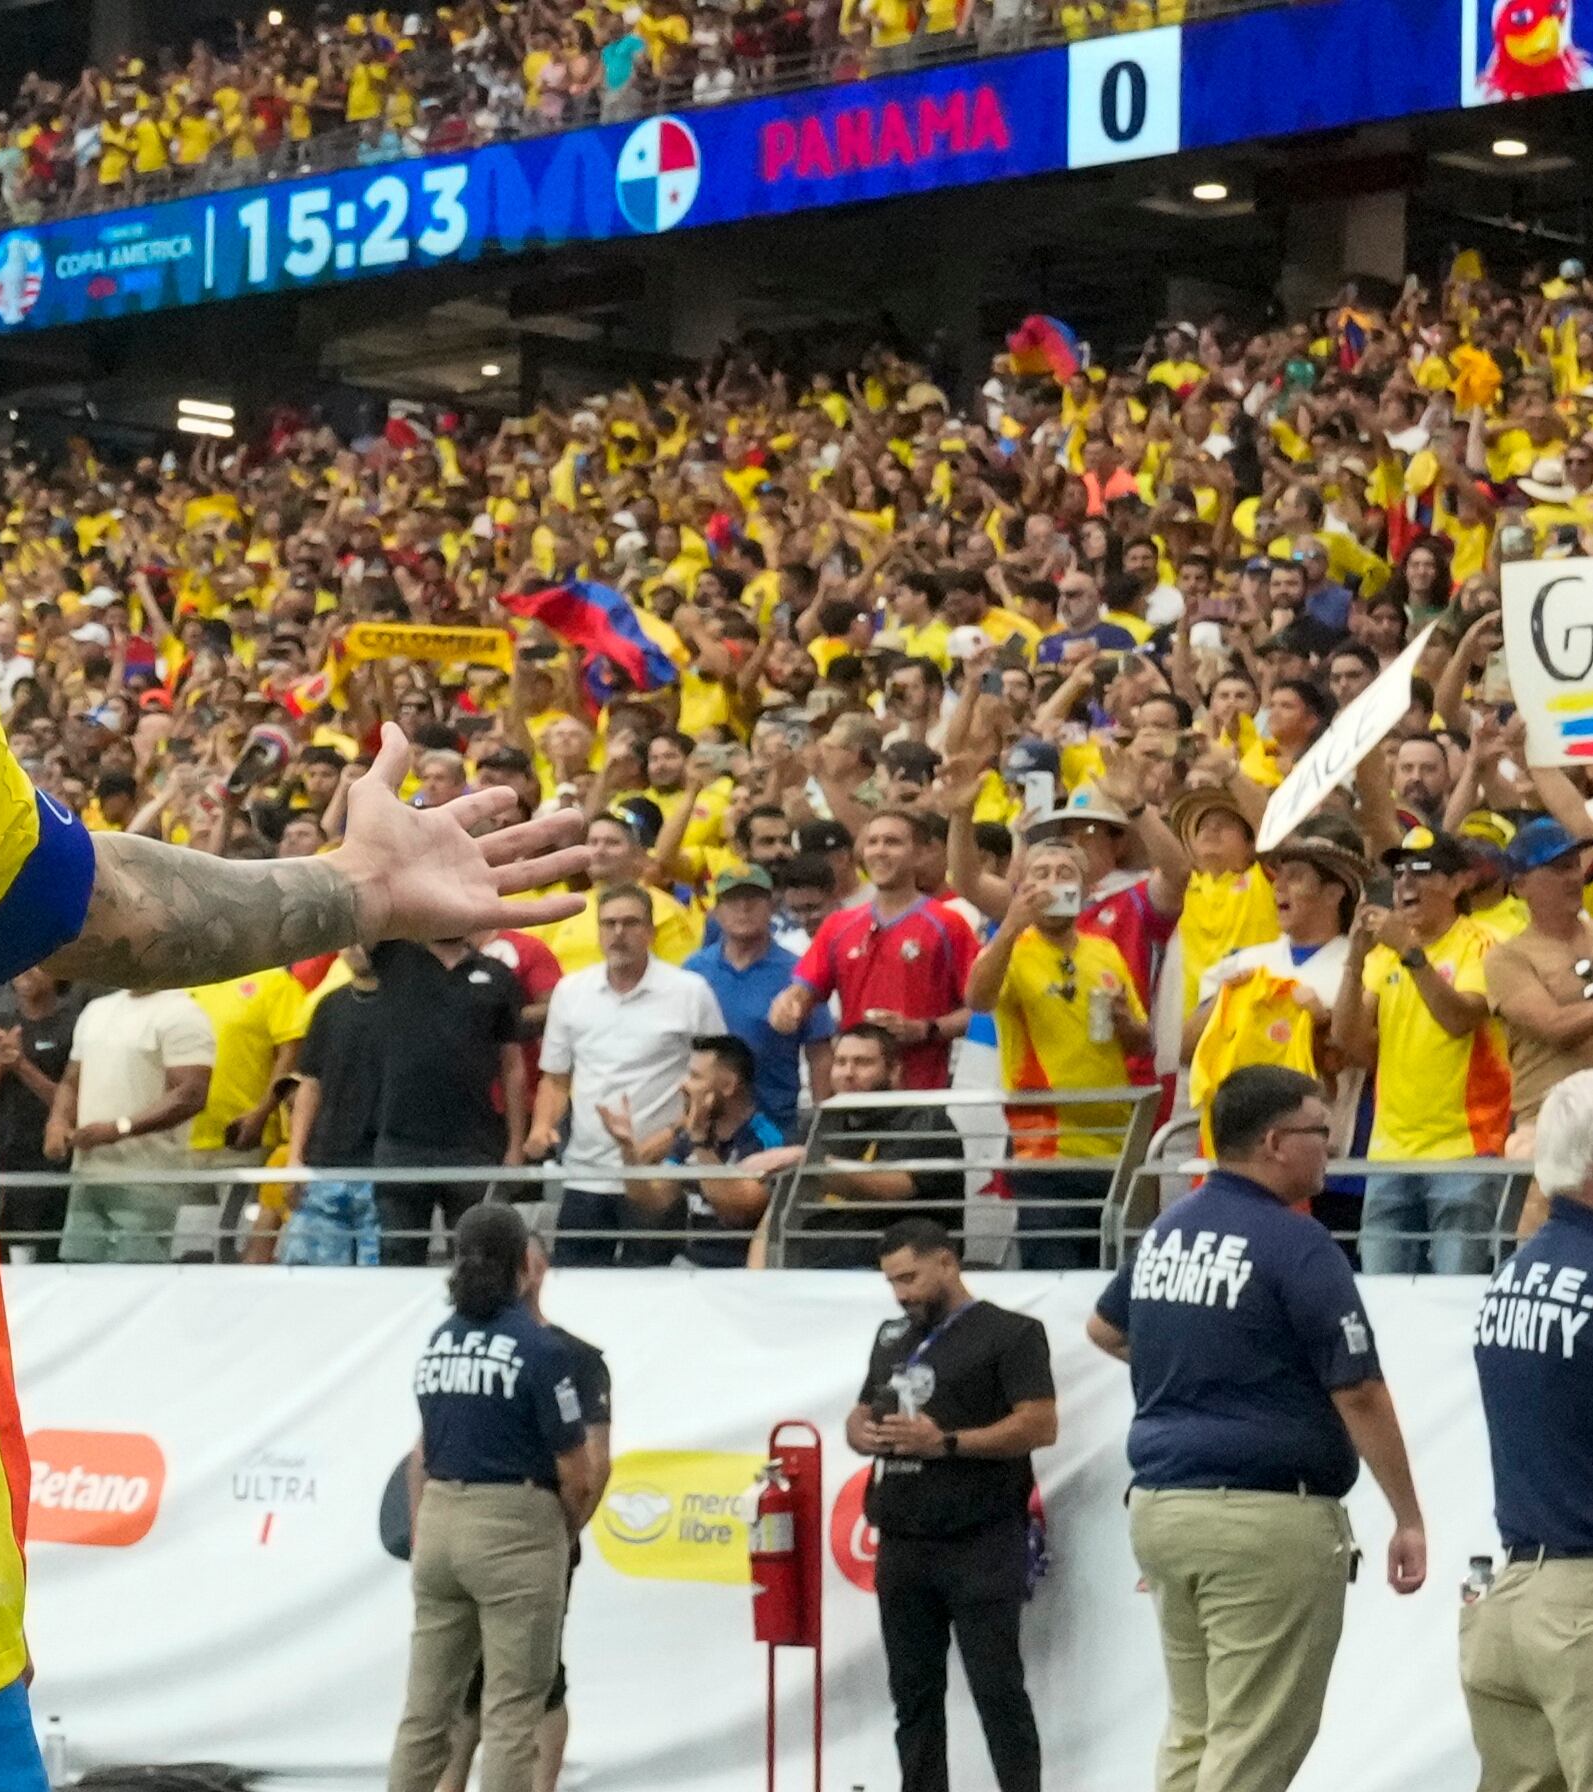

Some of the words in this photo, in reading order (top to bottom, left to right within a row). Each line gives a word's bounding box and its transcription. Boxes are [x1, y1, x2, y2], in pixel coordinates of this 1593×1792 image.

[1100, 60, 1148, 143] 0
[764, 85, 1010, 182] PANAMA
[239, 164, 468, 283] 15:23
[56, 251, 106, 280] COPA
[110, 235, 192, 268] AMERICA
[1130, 1258, 1251, 1309] SECURITY
[1473, 1297, 1590, 1359] ECURITY
[417, 1356, 521, 1399] ECURITY
[30, 1460, 149, 1514] Betano
[232, 1473, 317, 1502] ULTRA
[682, 1493, 745, 1514] merc
[679, 1516, 733, 1545] libre
